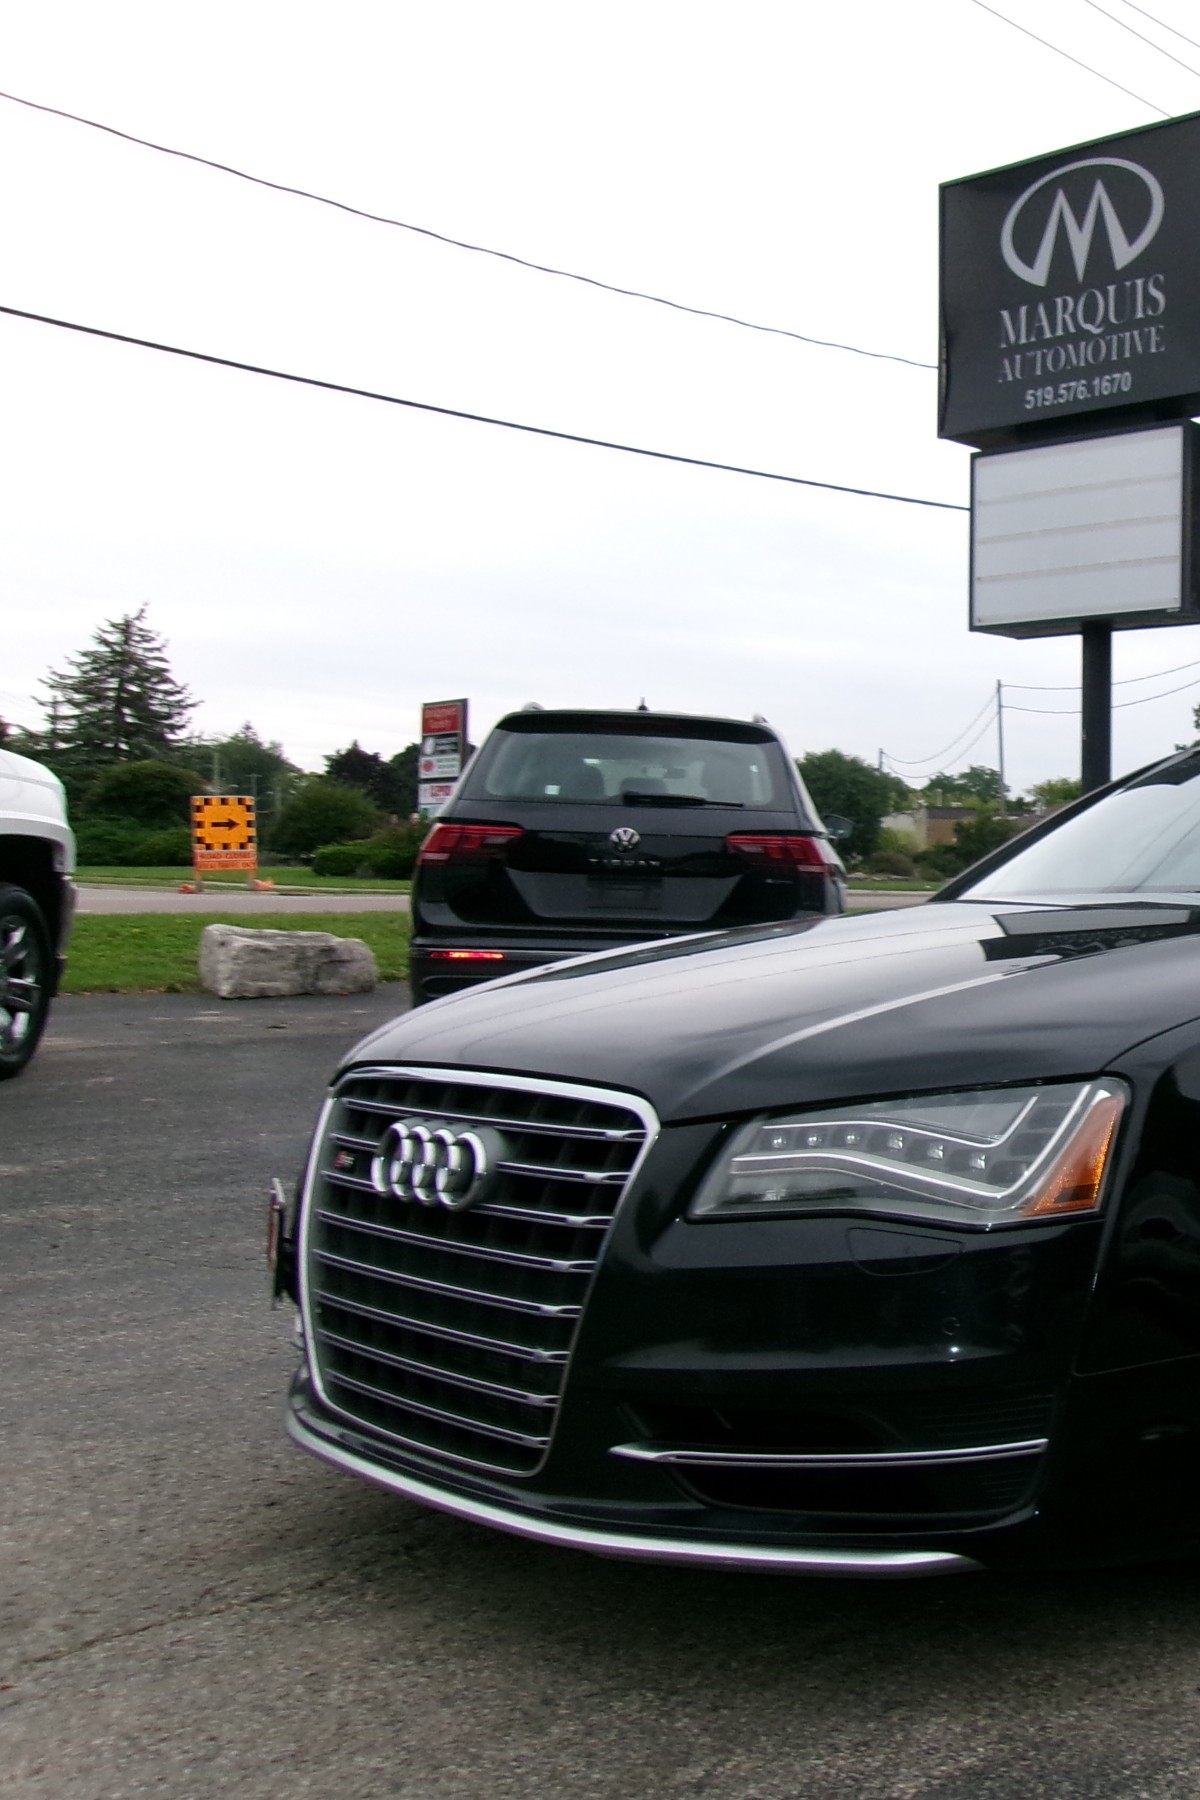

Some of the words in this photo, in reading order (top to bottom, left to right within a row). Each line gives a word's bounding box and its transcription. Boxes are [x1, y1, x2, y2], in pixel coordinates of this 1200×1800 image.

[1000, 273, 1166, 348] MARQUIS
[997, 324, 1166, 383] AUTOMOTIVE
[1024, 371, 1132, 410] 519.576.1670
